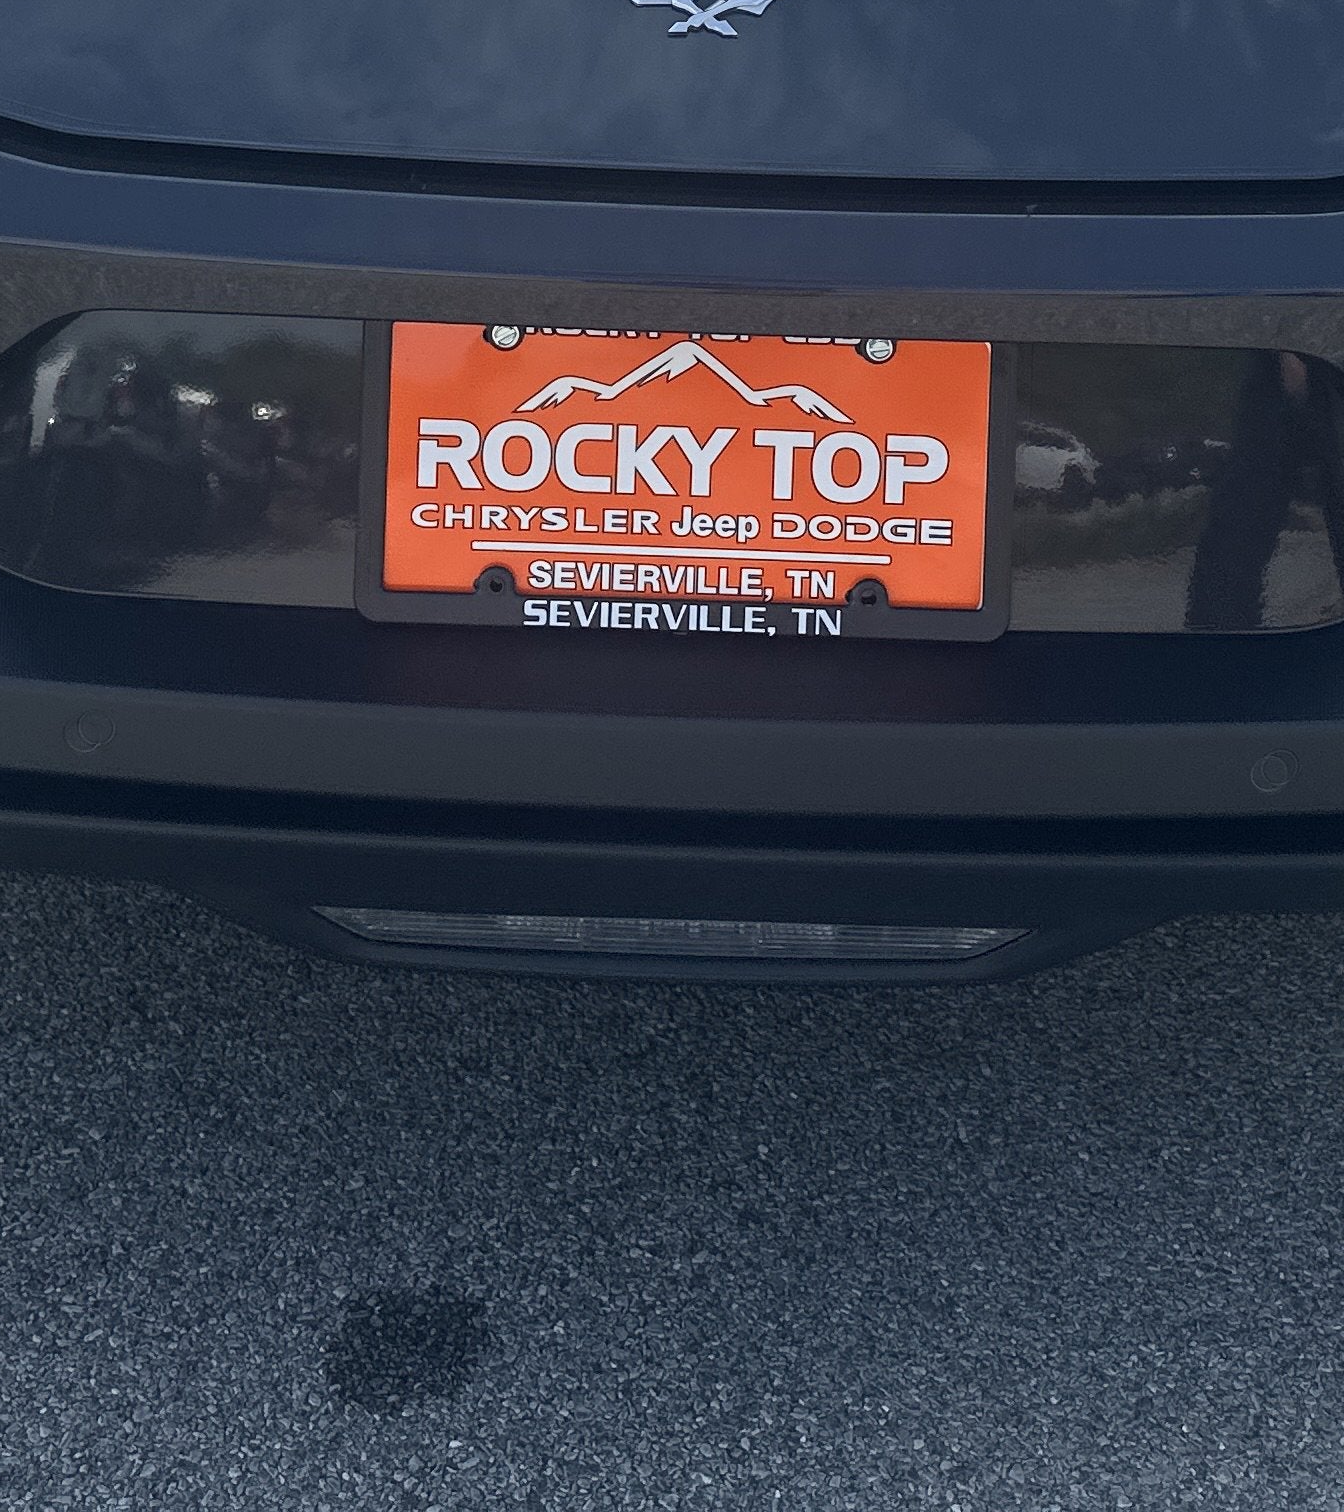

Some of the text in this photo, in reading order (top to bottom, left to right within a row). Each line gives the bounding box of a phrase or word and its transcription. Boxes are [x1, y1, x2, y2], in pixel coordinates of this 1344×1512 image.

[416, 417, 950, 506] ROCKY TOP
[411, 502, 954, 547] CHRYSLER Jeep DODGE
[528, 560, 836, 602] SEVIERVILLE, TN
[522, 599, 842, 637] SEVIERVILLE, TN
